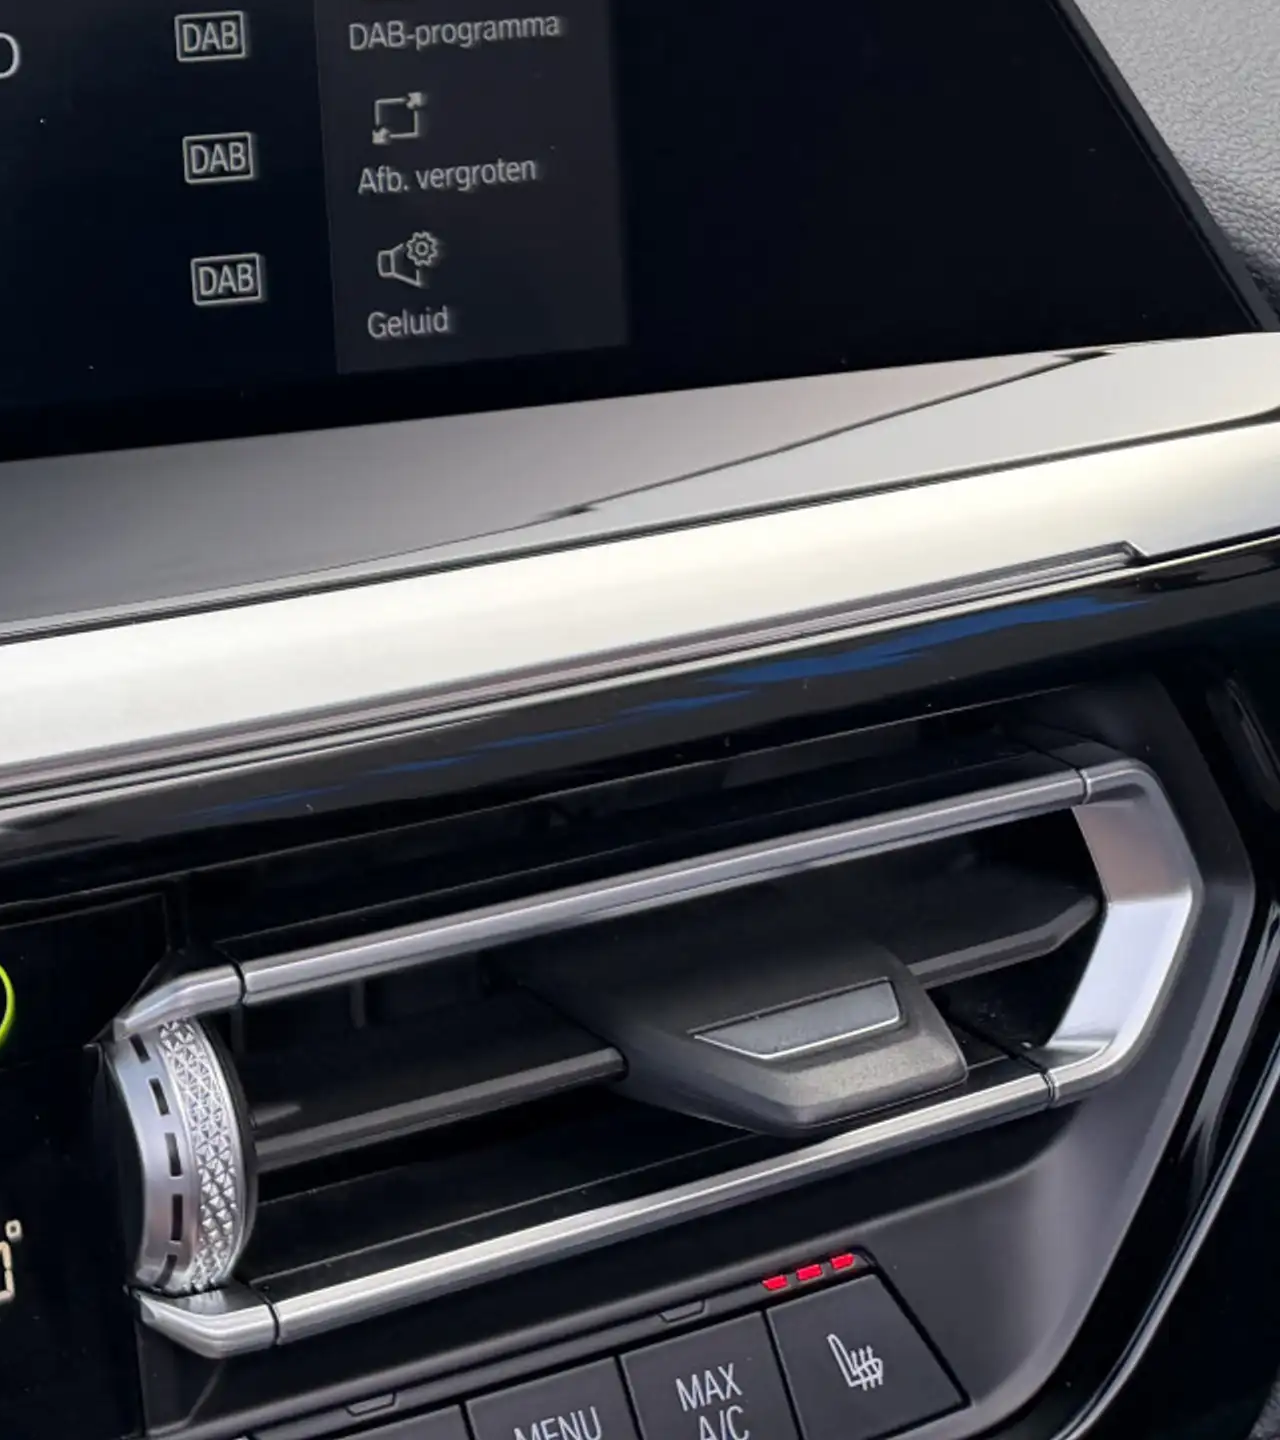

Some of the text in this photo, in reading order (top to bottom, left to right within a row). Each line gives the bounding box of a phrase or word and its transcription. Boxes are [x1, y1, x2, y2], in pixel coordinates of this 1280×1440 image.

[181, 20, 239, 54] DAB
[349, 16, 560, 50] DAB-programma
[189, 141, 247, 176] DAB
[359, 159, 536, 193] Afb. vergroten
[197, 263, 255, 298] DAB
[368, 306, 449, 338] Geluid
[675, 1363, 743, 1412] MAX
[697, 1405, 750, 1440] A/C
